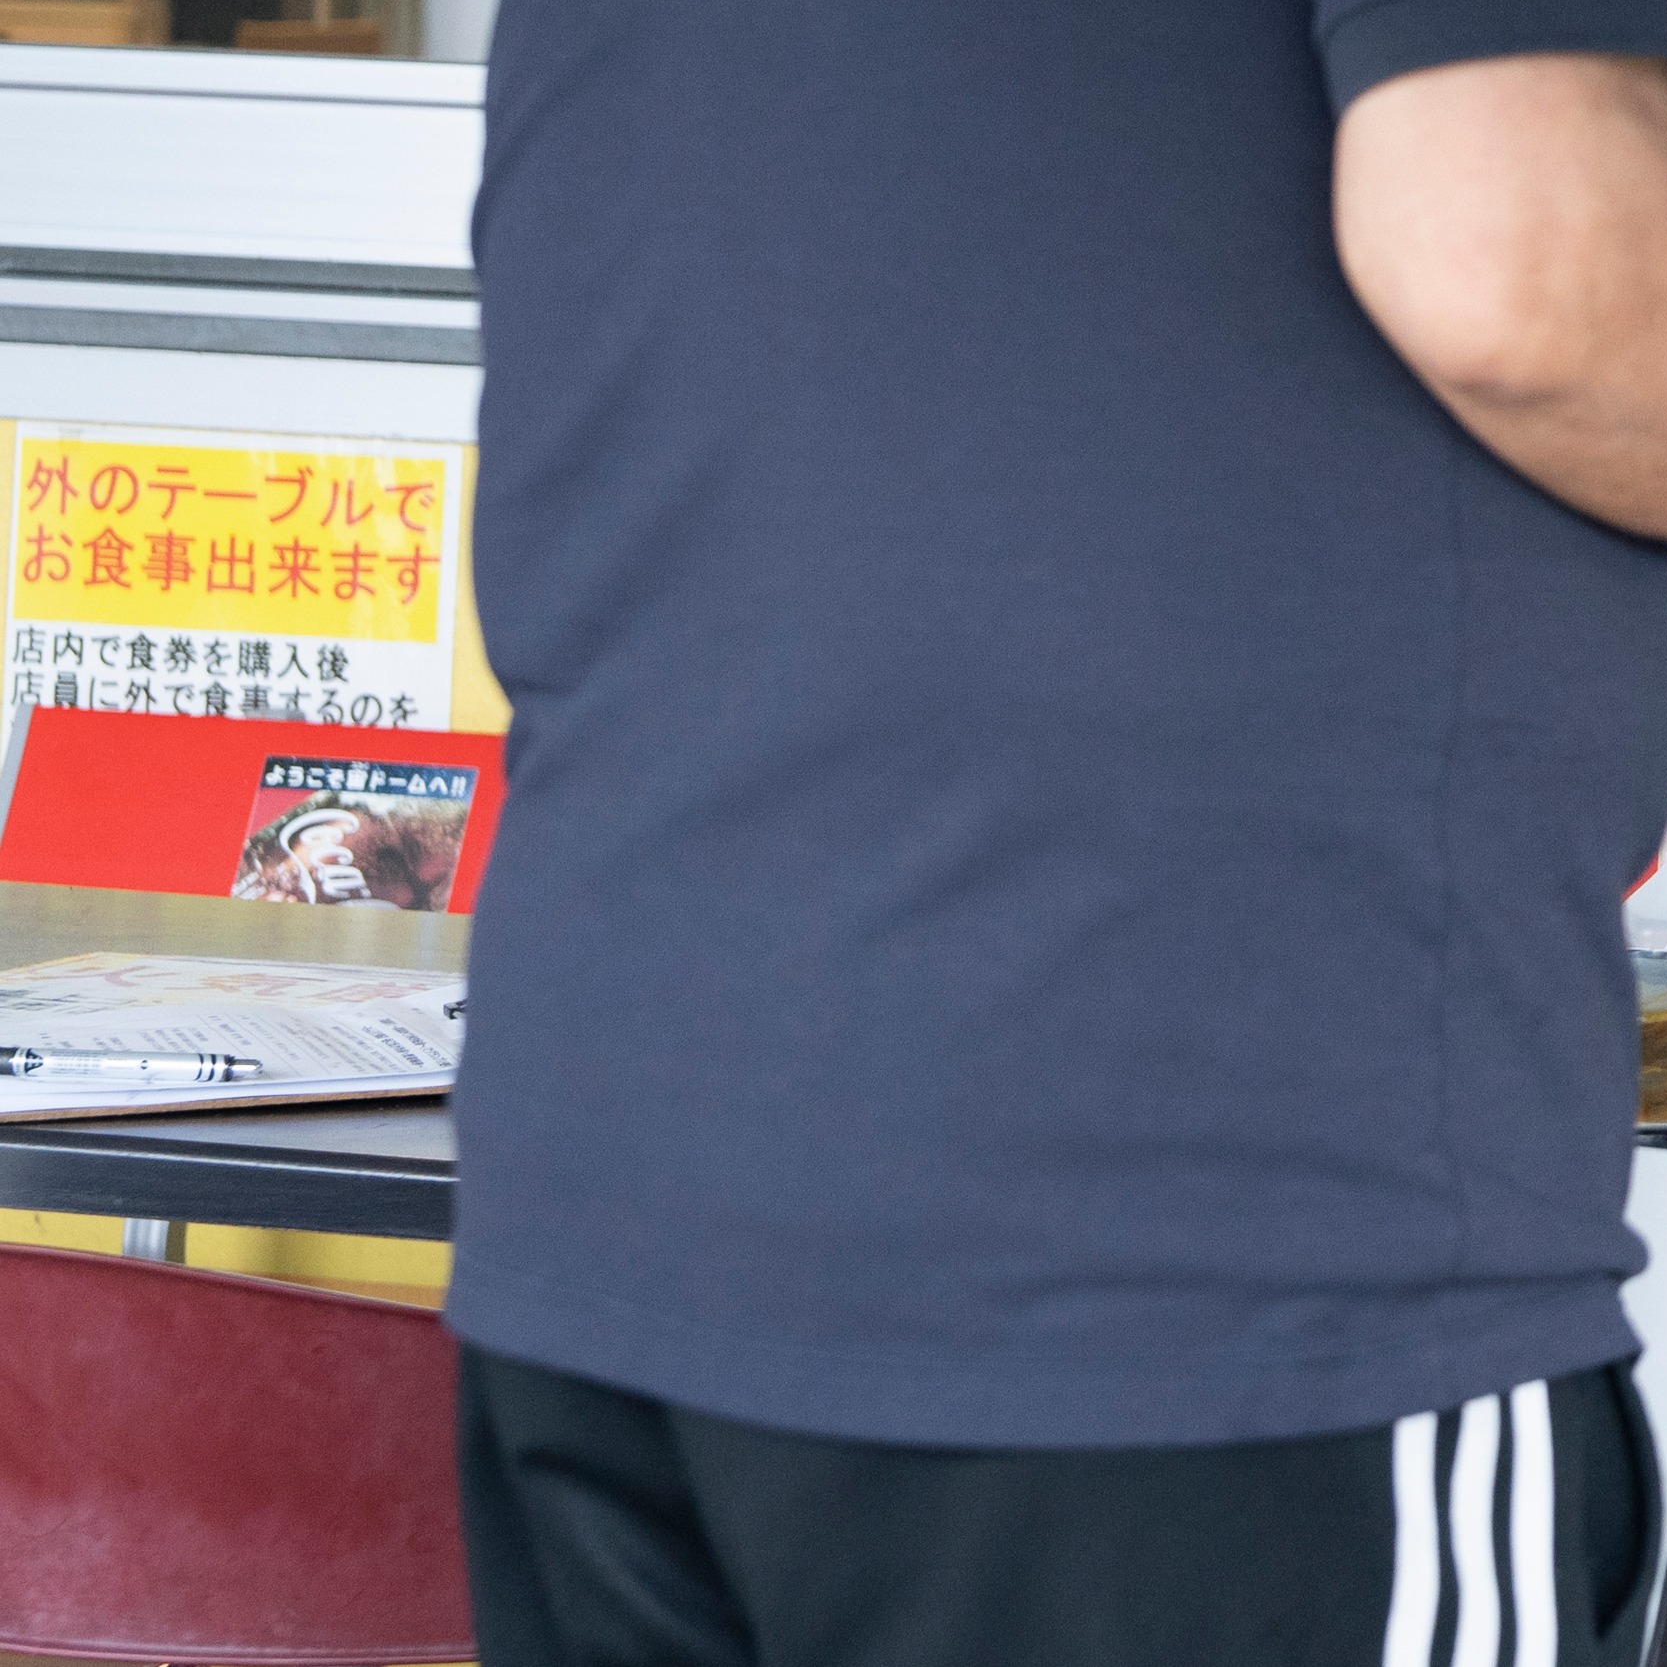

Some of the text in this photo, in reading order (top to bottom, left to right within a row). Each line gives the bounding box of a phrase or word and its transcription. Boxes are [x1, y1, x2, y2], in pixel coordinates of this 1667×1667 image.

[26, 455, 437, 535] 外のテーブルで
[22, 524, 441, 607] お食事出来ます
[11, 625, 352, 684] 店内で食券を購入後
